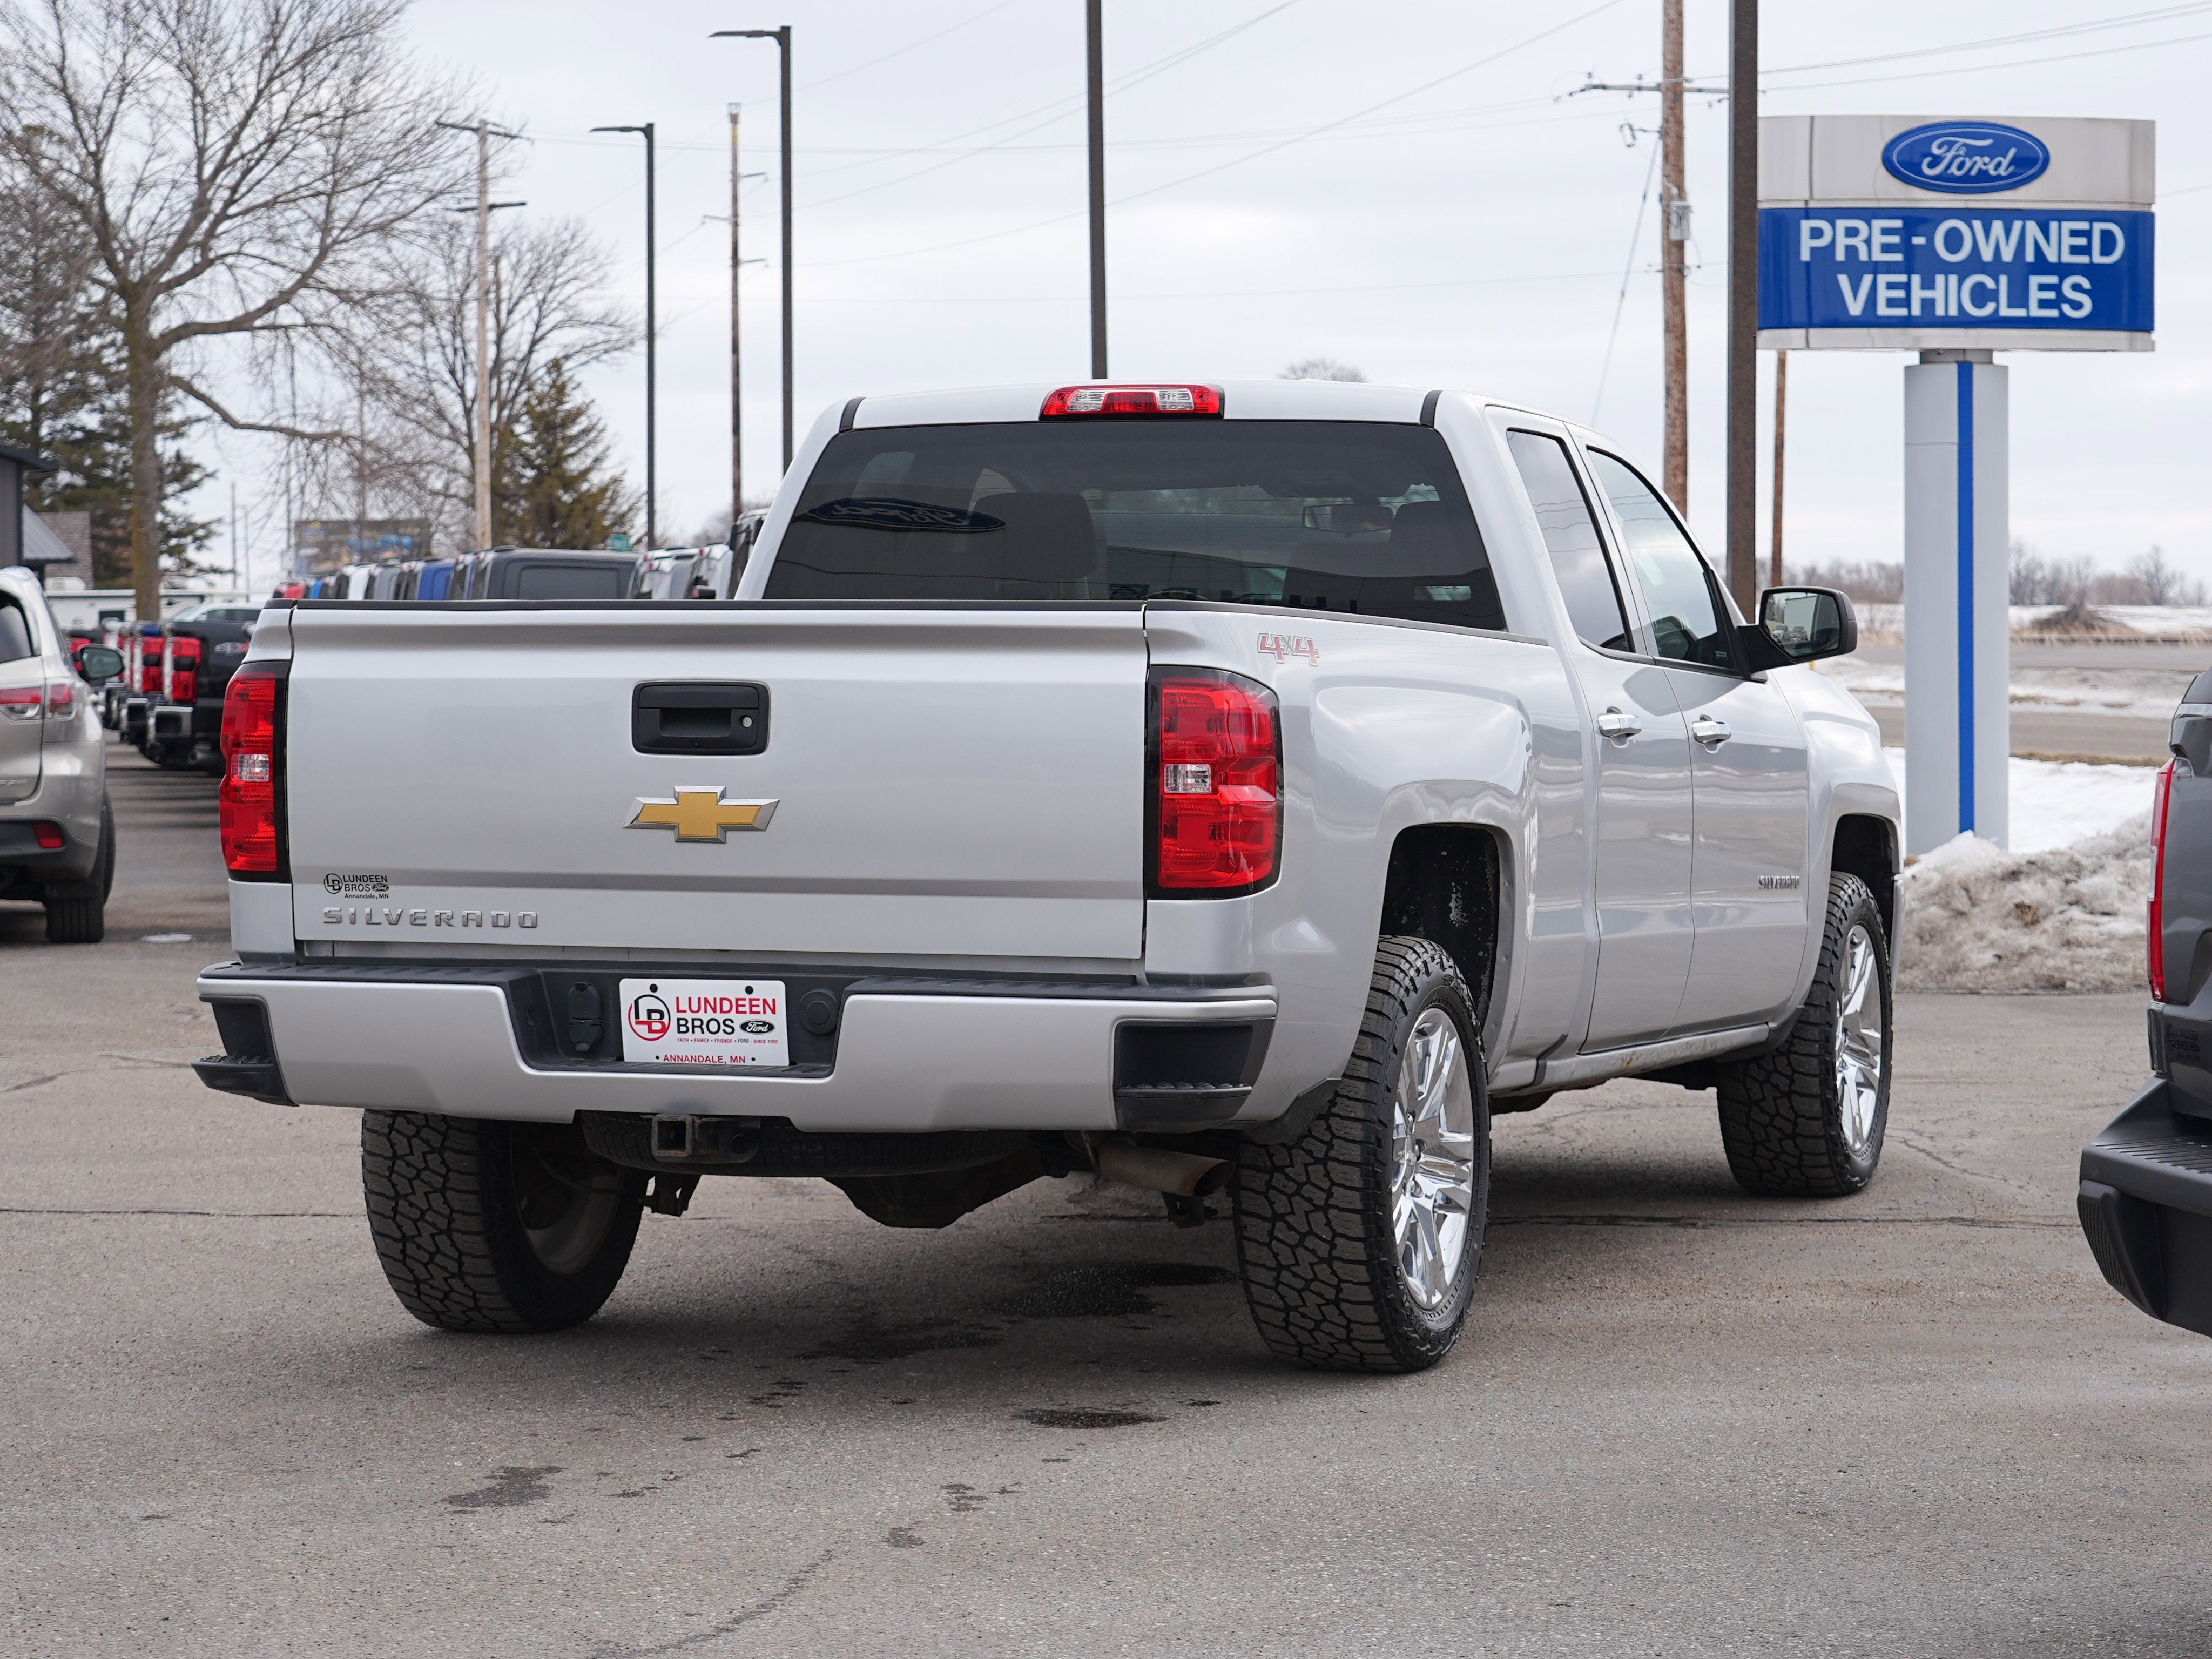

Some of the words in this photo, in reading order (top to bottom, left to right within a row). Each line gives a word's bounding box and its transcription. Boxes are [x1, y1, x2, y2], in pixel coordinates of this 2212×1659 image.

[1921, 136, 2018, 177] Ford
[1800, 218, 2126, 264] PRE-OWNED
[1837, 273, 2093, 318] VEHICLES
[343, 875, 388, 883] LUNDEEN
[345, 884, 371, 892] BROS
[323, 907, 538, 928] SILVERADO
[676, 997, 777, 1015] LUNDEEN
[677, 1017, 736, 1035] BROS
[744, 1020, 770, 1033] Ford
[663, 1054, 727, 1065] ANNANDALE,
